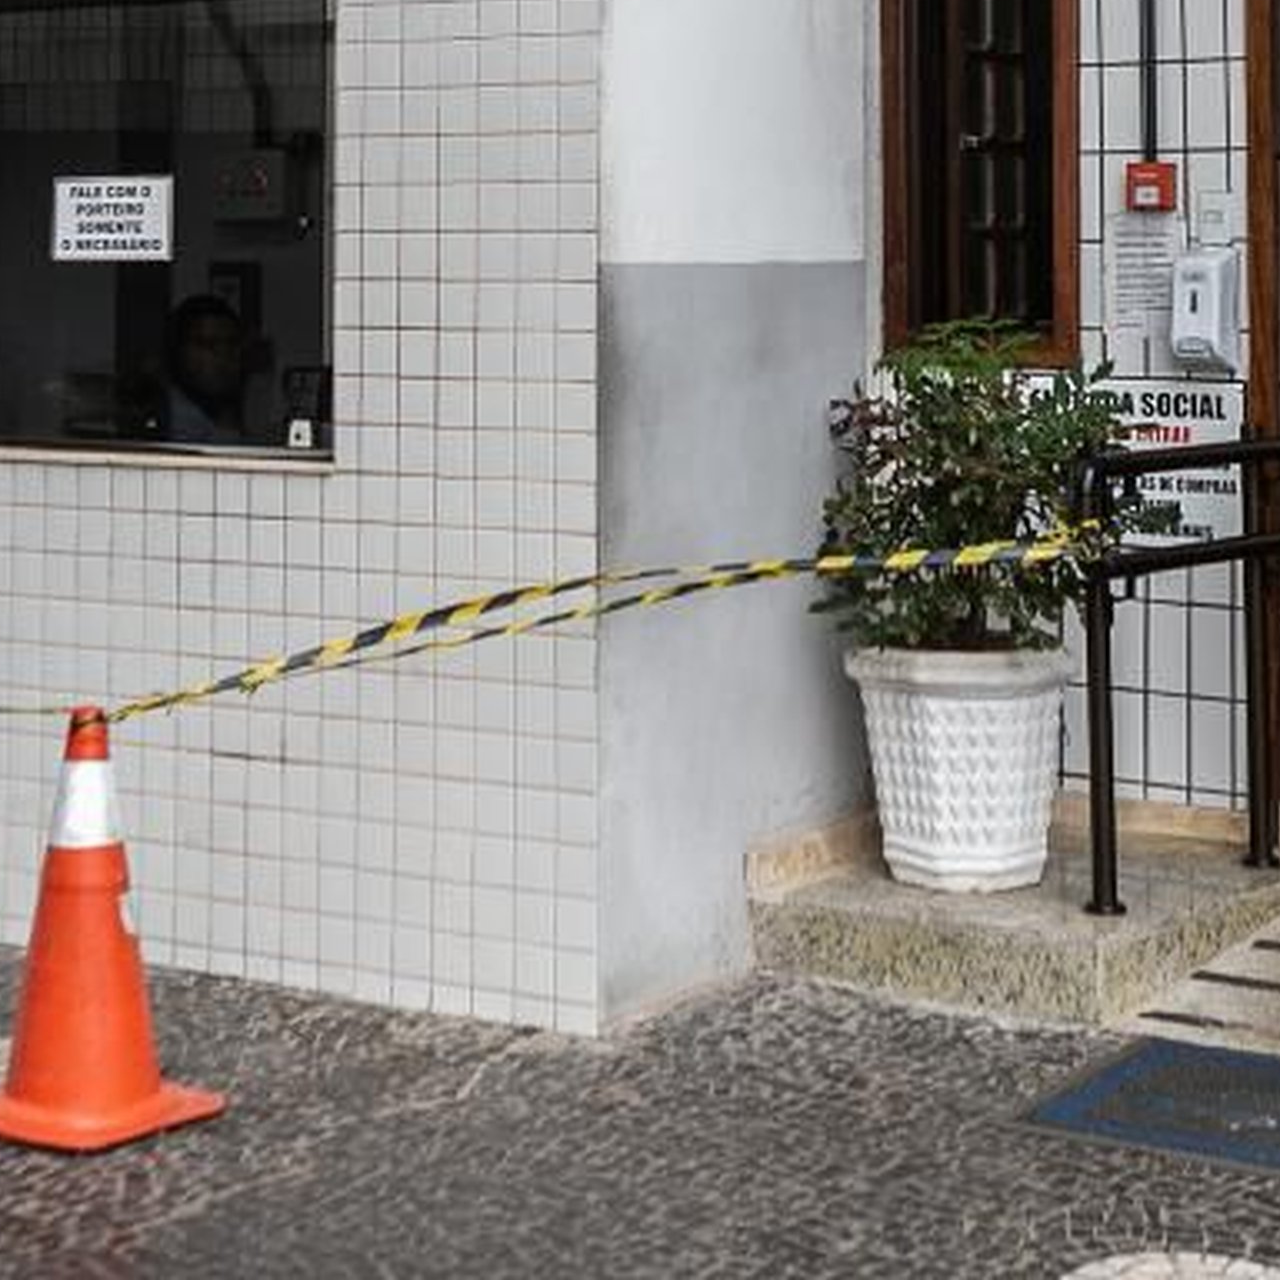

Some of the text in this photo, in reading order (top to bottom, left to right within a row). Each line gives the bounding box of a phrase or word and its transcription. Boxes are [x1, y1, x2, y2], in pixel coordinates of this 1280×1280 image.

[69, 185, 151, 198] FALE COM O
[75, 202, 145, 216] PORTEIRO
[76, 220, 144, 234] SOMENTE
[61, 239, 71, 251] O
[1141, 392, 1227, 419] SOCIAL
